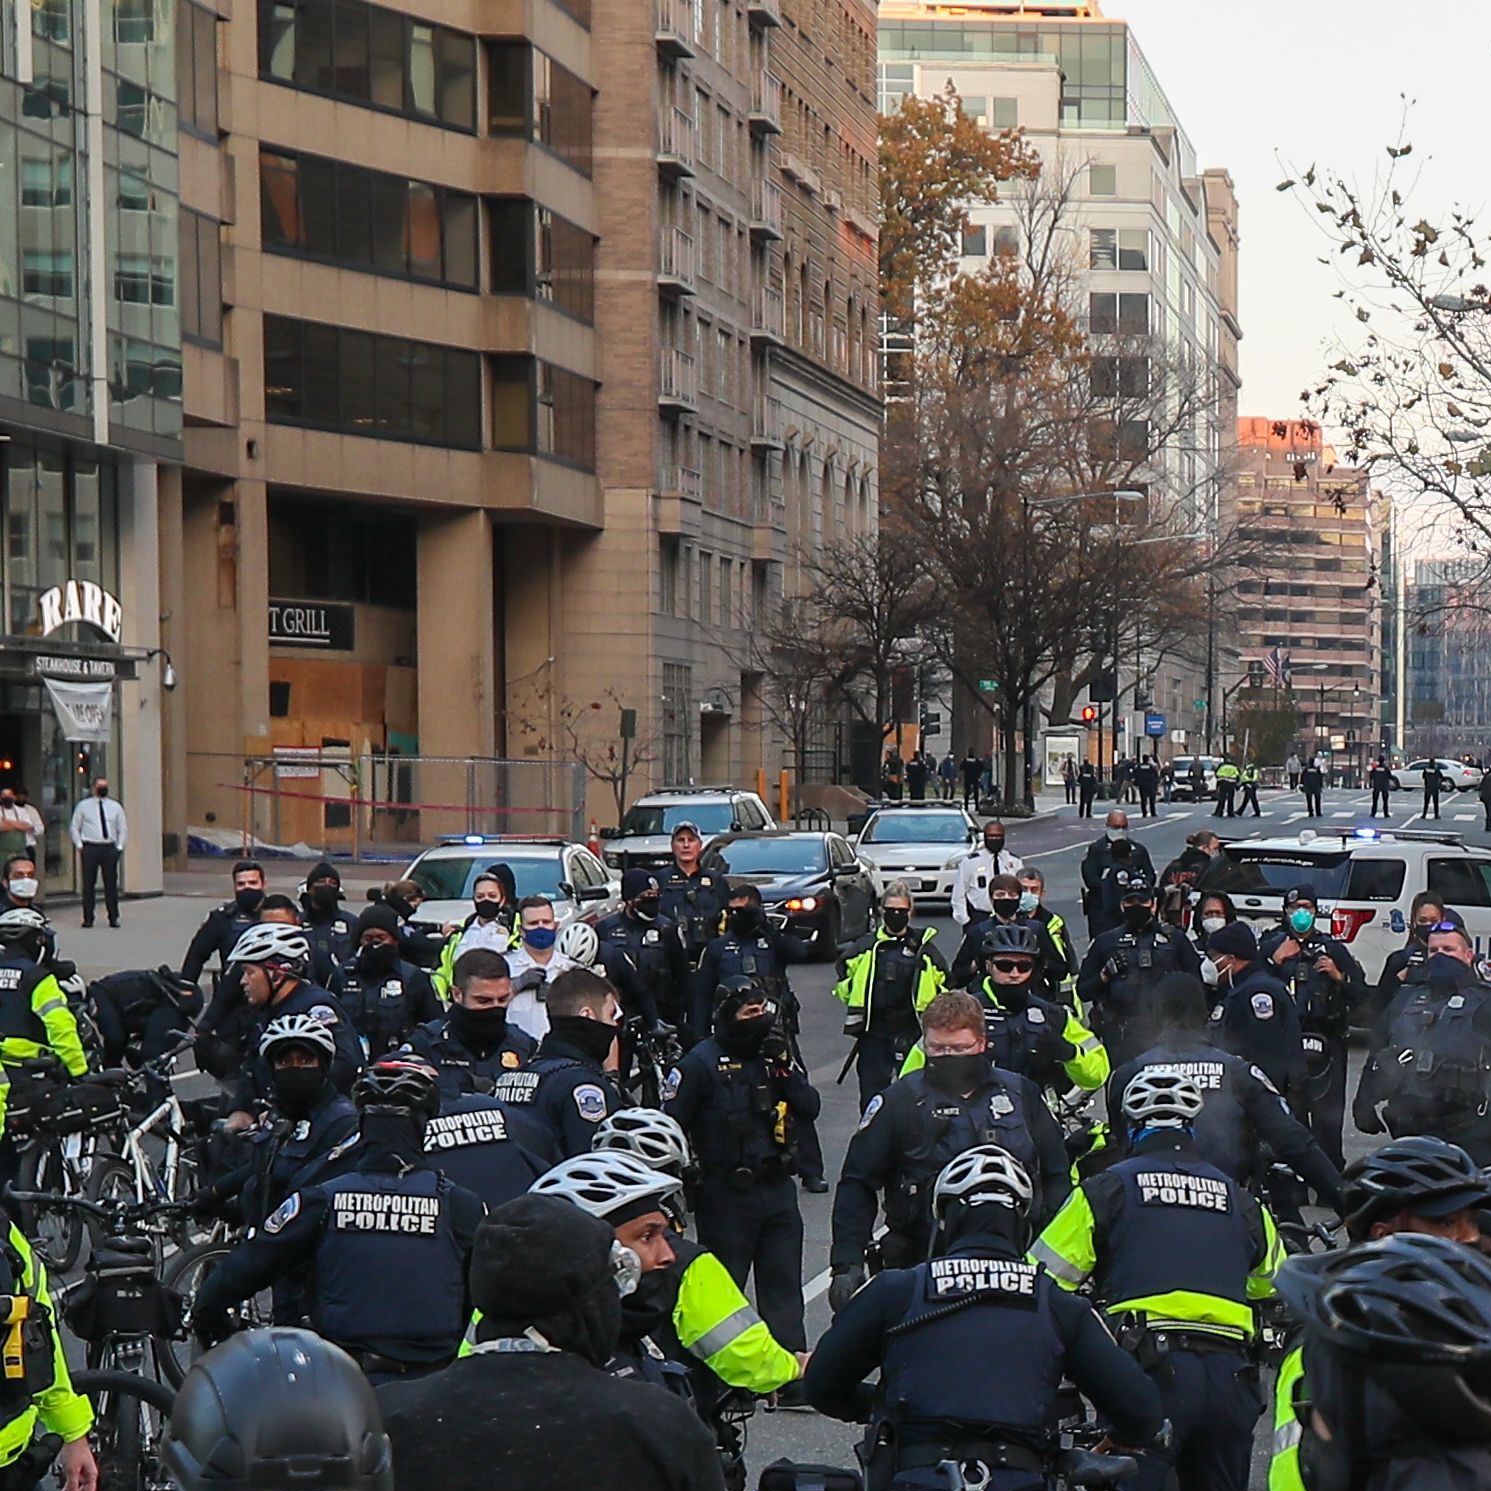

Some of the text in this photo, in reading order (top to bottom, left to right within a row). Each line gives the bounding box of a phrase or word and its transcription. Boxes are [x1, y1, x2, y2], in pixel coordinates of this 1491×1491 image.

[39, 580, 122, 643] RARE
[283, 608, 330, 635] GRILL
[36, 656, 81, 673] STEAKHOUSE
[1137, 1173, 1228, 1194] METROPOLITAN
[334, 1192, 439, 1216] METROPOLITAN
[1142, 1187, 1228, 1211] POLICE
[337, 1211, 436, 1234] POLICE
[931, 1259, 1037, 1278] METROPOLITAN
[936, 1272, 1034, 1294] POLICE
